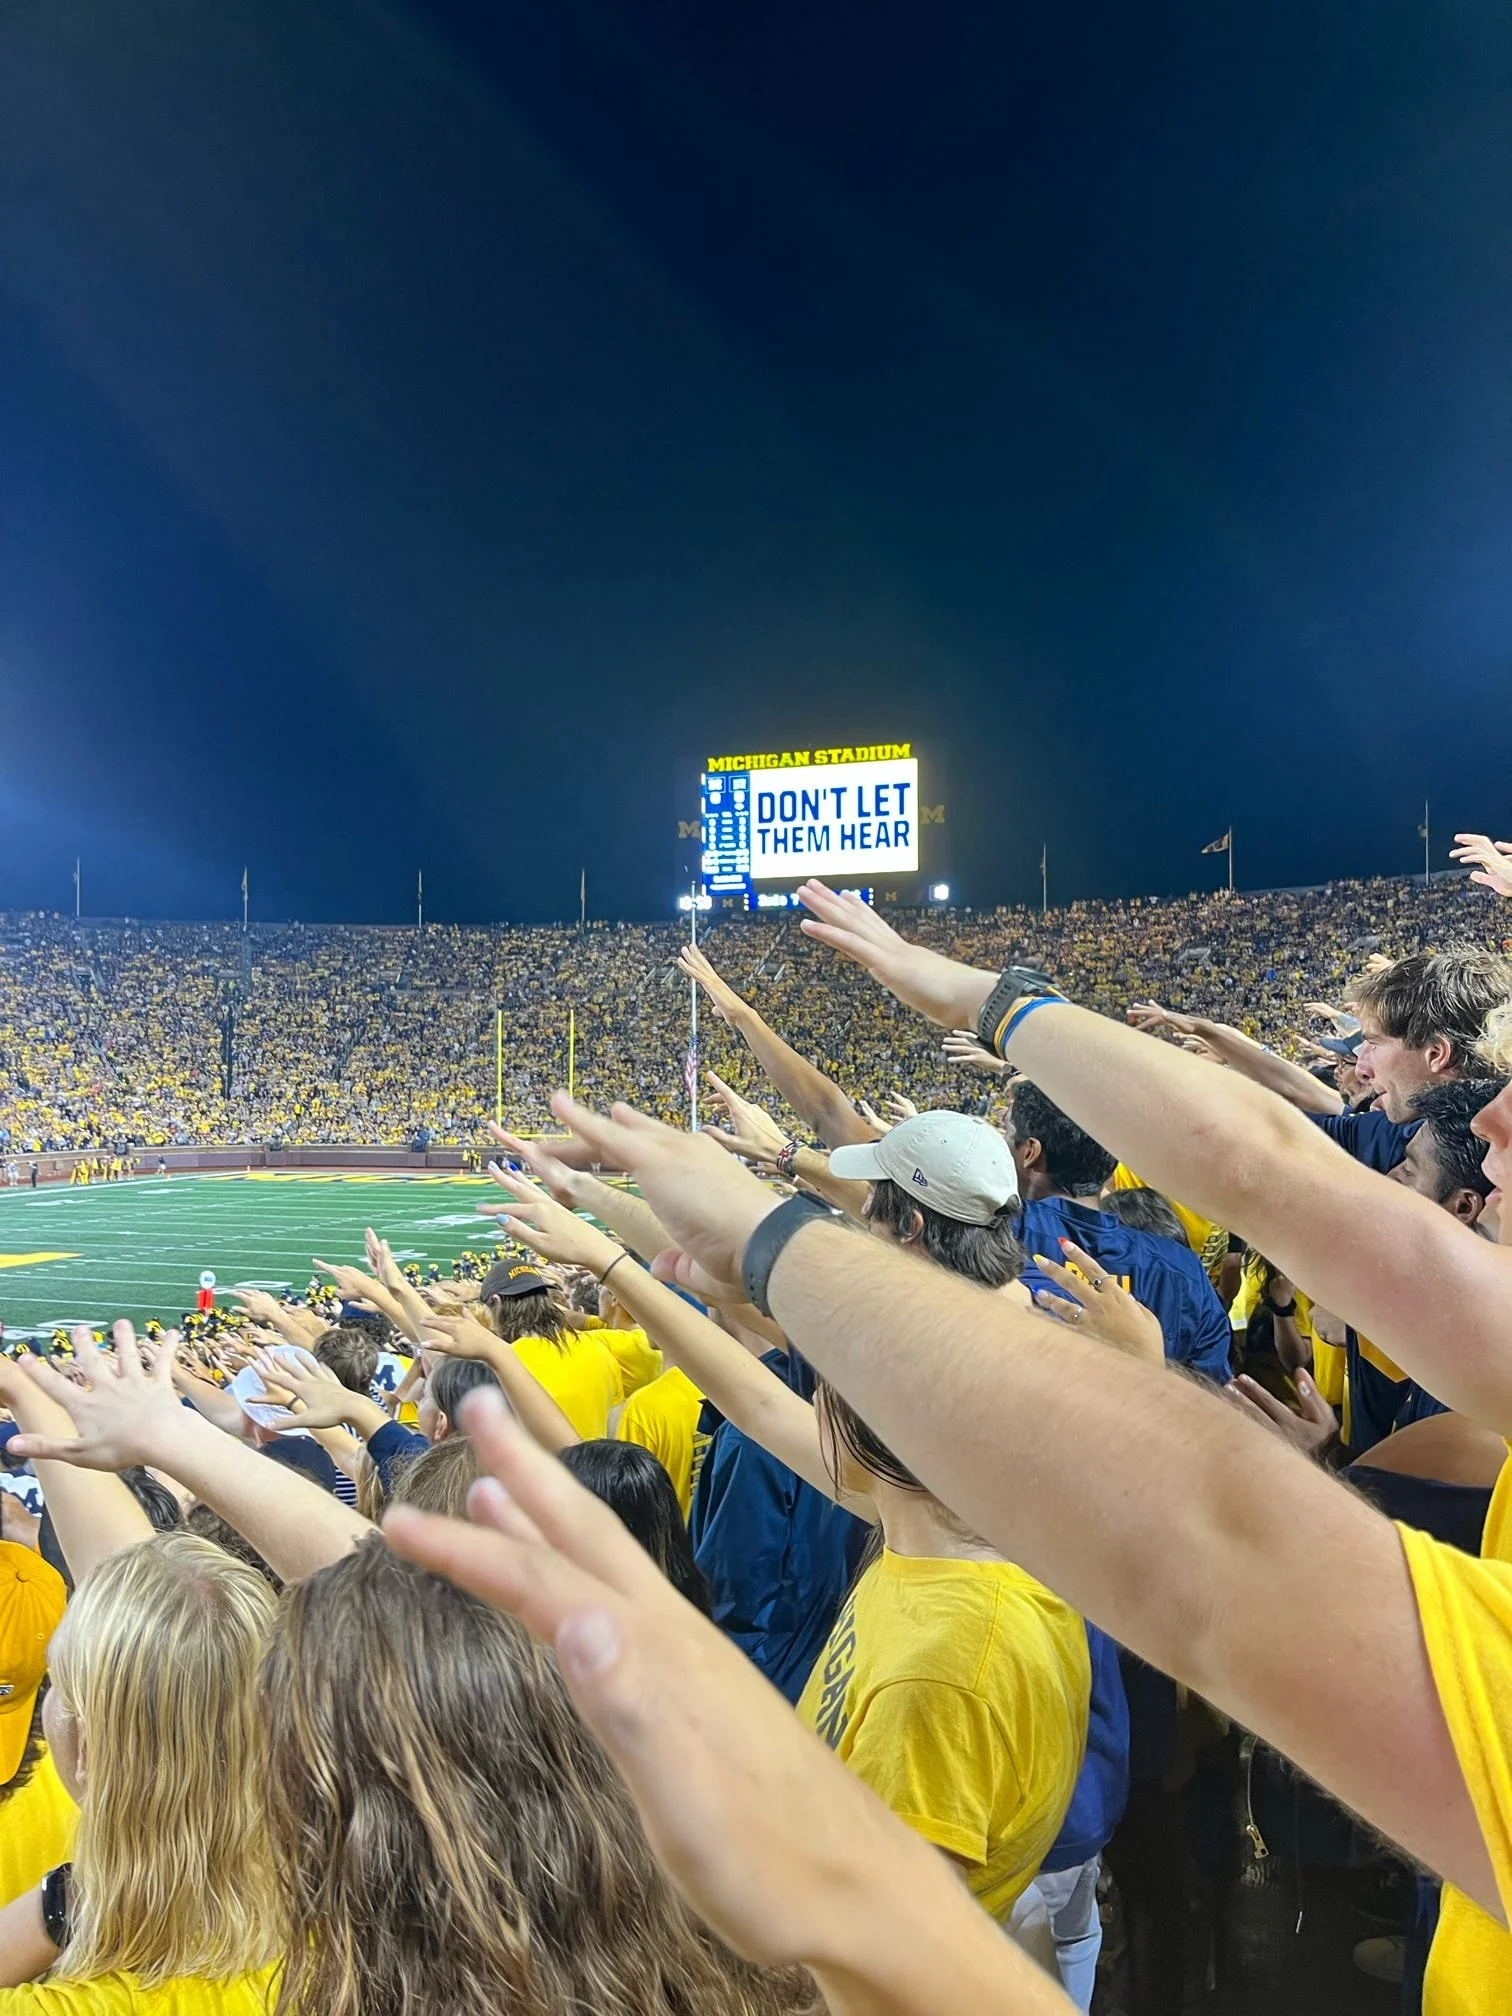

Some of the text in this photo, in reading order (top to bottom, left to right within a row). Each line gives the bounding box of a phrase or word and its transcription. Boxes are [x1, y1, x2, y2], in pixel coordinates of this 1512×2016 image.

[707, 743, 911, 773] MICHIGAN STADIUM
[758, 782, 911, 824] DON'T LET
[757, 820, 909, 854] THEM HEAR
